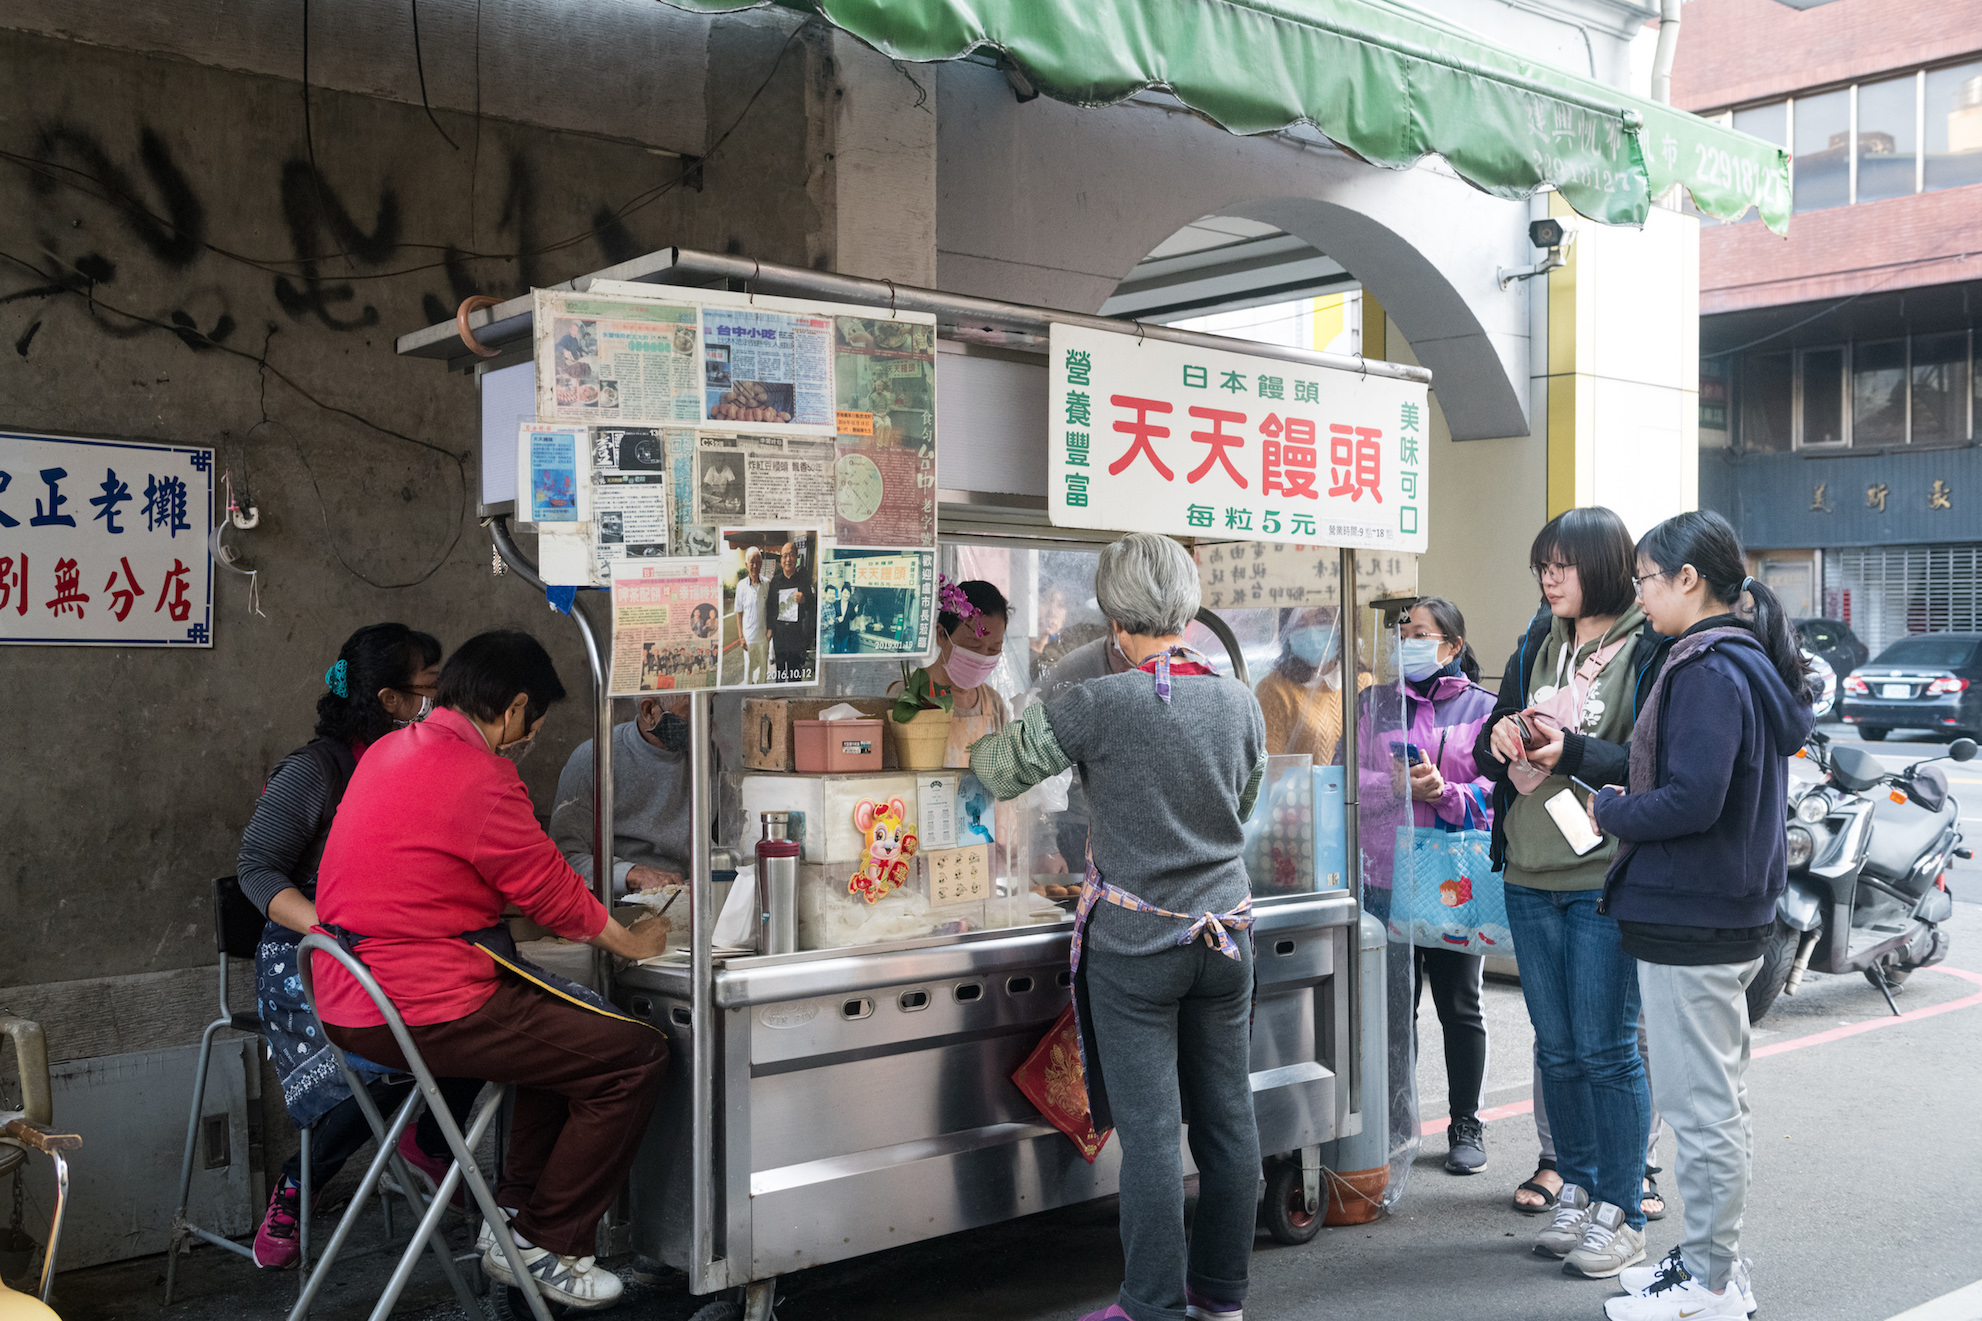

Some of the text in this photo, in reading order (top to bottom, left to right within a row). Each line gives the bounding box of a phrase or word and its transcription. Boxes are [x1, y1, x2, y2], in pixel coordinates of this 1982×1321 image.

[717, 325, 776, 339] 台中小吃
[887, 363, 916, 374] 天天饅頭
[1183, 364, 1320, 405] 日本饅頭
[650, 429, 663, 437] 130
[1065, 349, 1092, 508] 營養豐富
[701, 438, 714, 446] C3
[1108, 394, 1385, 504] 天天饅頭
[1400, 401, 1419, 535] 美味可口
[1186, 502, 1316, 536] 每粒5元
[858, 566, 907, 581] 天天饅頭
[0, 552, 191, 622] 別無分店
[917, 554, 932, 649] 歡迎盧市長蒞臨
[875, 641, 913, 650] 2019.01.19
[766, 668, 812, 680] 2016.10.12
